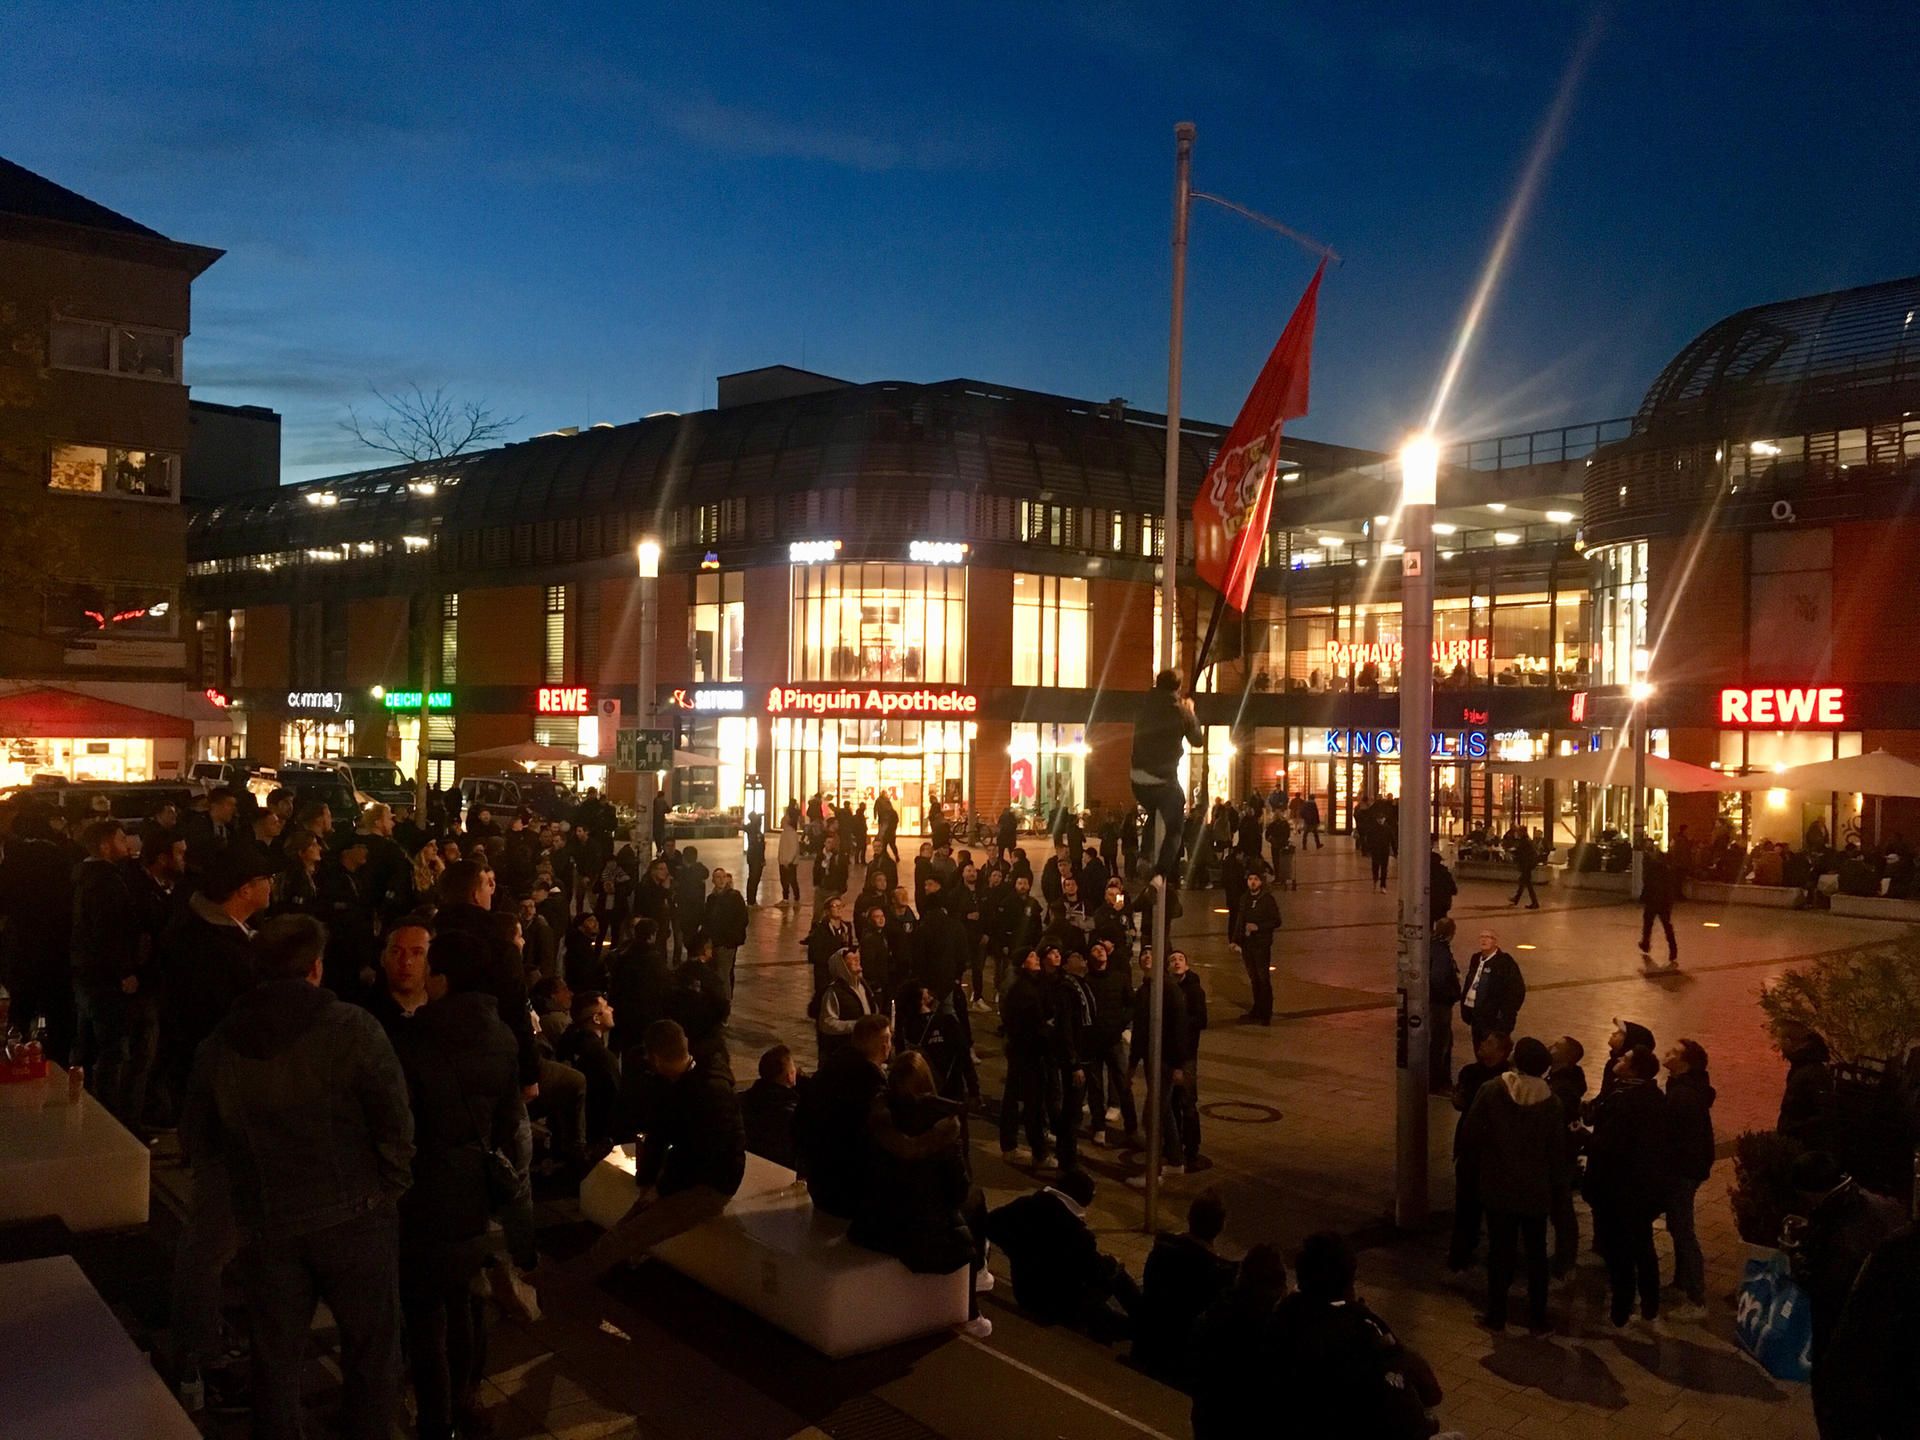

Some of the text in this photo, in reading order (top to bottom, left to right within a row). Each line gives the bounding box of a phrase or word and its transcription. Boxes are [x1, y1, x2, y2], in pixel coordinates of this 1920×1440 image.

[1431, 639, 1488, 661] ALERIE
[385, 692, 452, 708] DEICHANN
[538, 687, 588, 713] REWE
[784, 689, 977, 715] Pinguin Apotheke
[1721, 688, 1845, 723] REWE
[1324, 729, 1486, 758] KINOLIS
